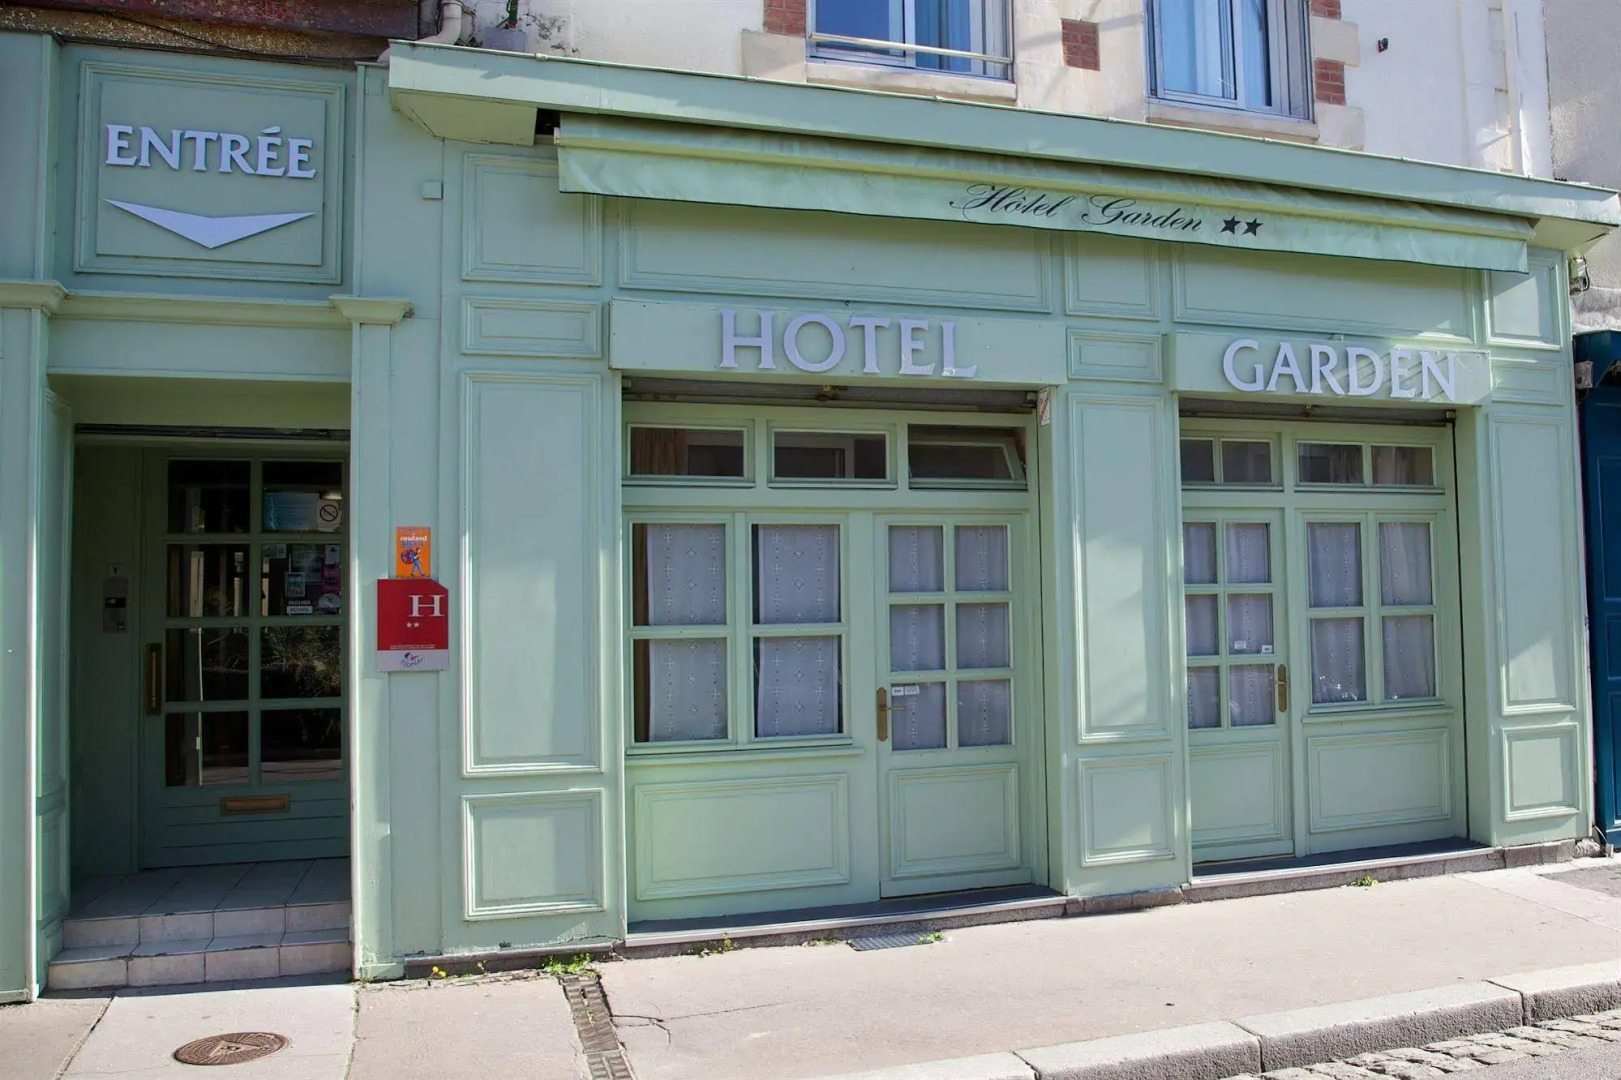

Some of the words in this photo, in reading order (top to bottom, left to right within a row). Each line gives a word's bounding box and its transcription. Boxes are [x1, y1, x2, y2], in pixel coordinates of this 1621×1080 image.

[106, 124, 316, 179] ENTRÉE
[1081, 193, 1203, 232] Garden
[720, 309, 978, 378] HOTEL
[1222, 338, 1457, 401] GARDEN
[408, 594, 446, 617] H
